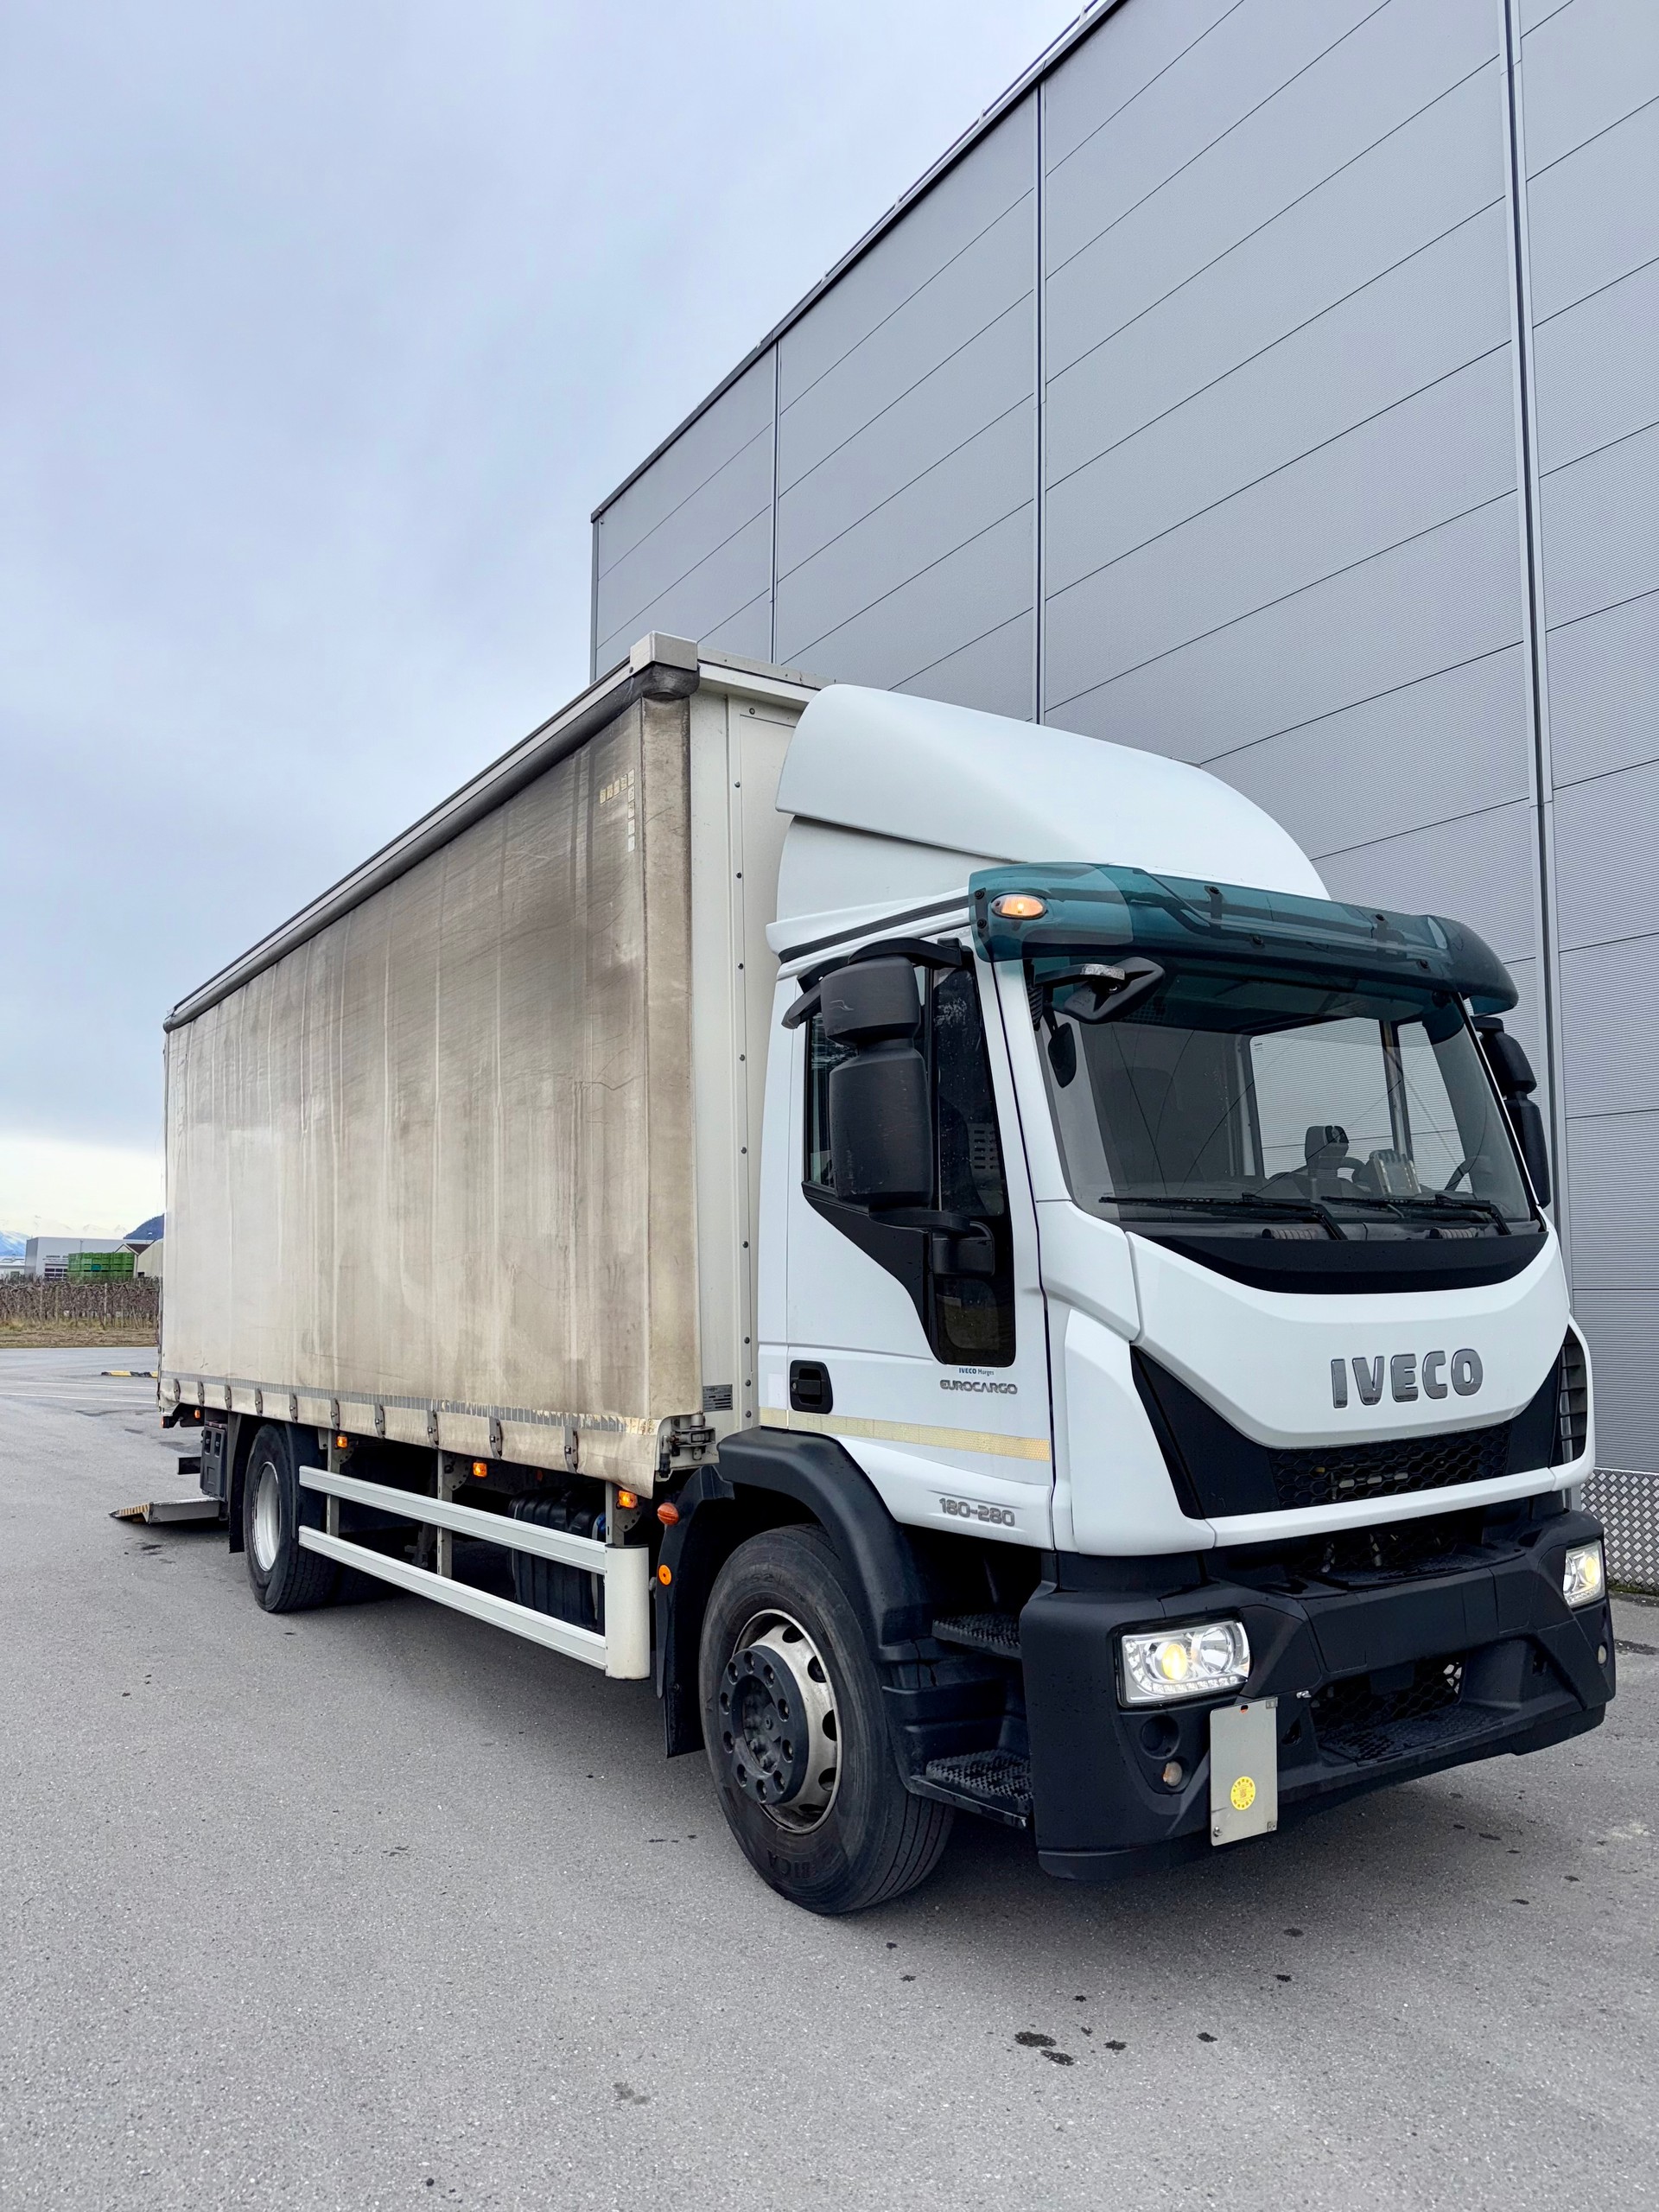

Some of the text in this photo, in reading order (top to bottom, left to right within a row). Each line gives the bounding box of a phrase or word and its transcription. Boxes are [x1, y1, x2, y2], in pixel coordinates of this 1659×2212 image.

[939, 1379, 1018, 1395] EUROCARGO
[1331, 1348, 1484, 1408] IVECO
[938, 1497, 1015, 1527] 180-280
